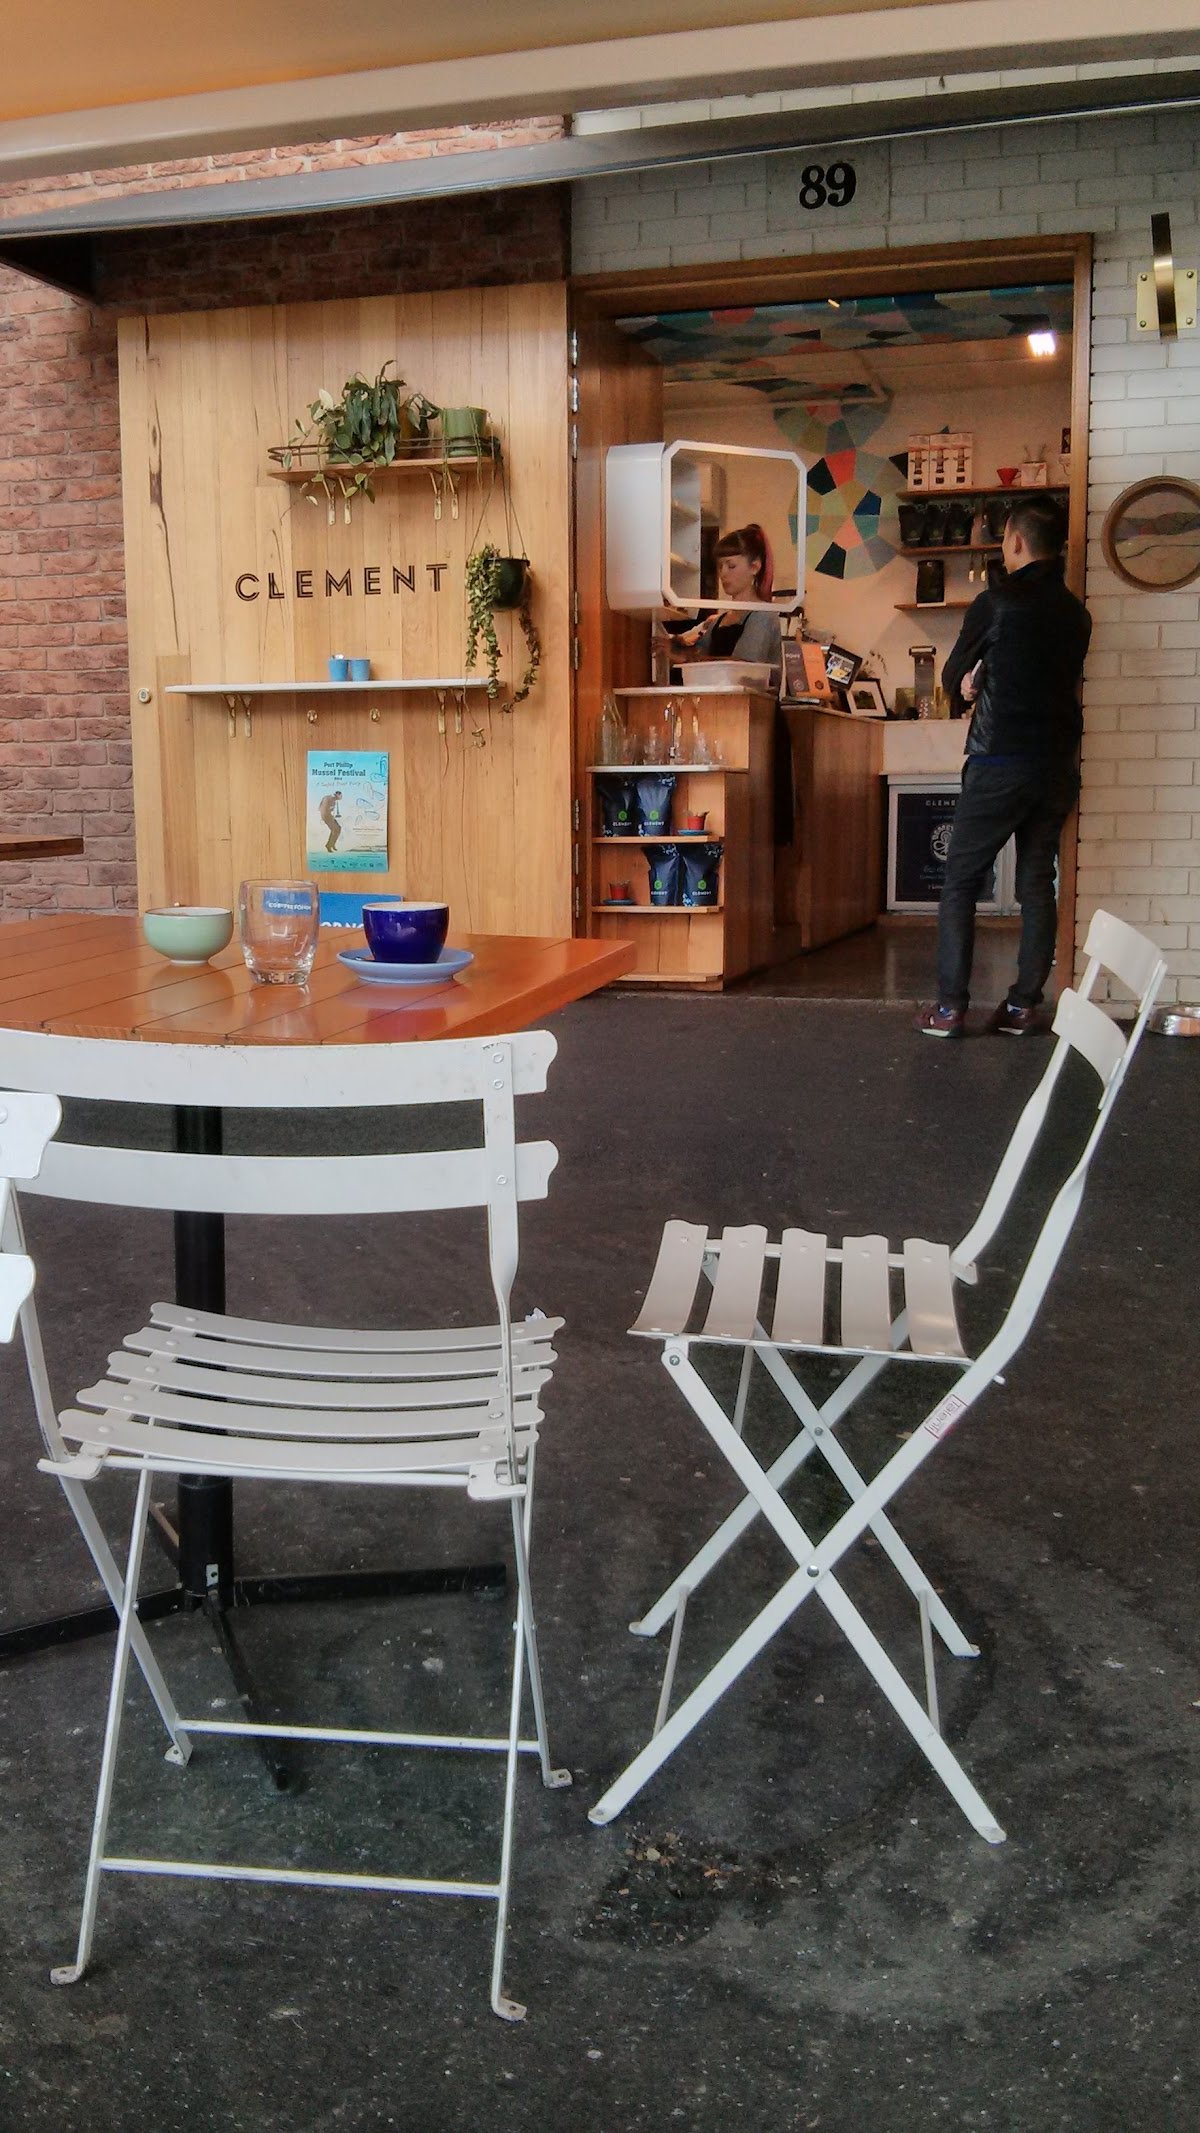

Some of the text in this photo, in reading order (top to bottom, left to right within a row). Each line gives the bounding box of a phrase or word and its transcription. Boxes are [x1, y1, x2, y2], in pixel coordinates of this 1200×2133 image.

[799, 163, 857, 210] 89
[235, 563, 448, 602] CLEMENT
[312, 768, 366, 777] Mussel Festival
